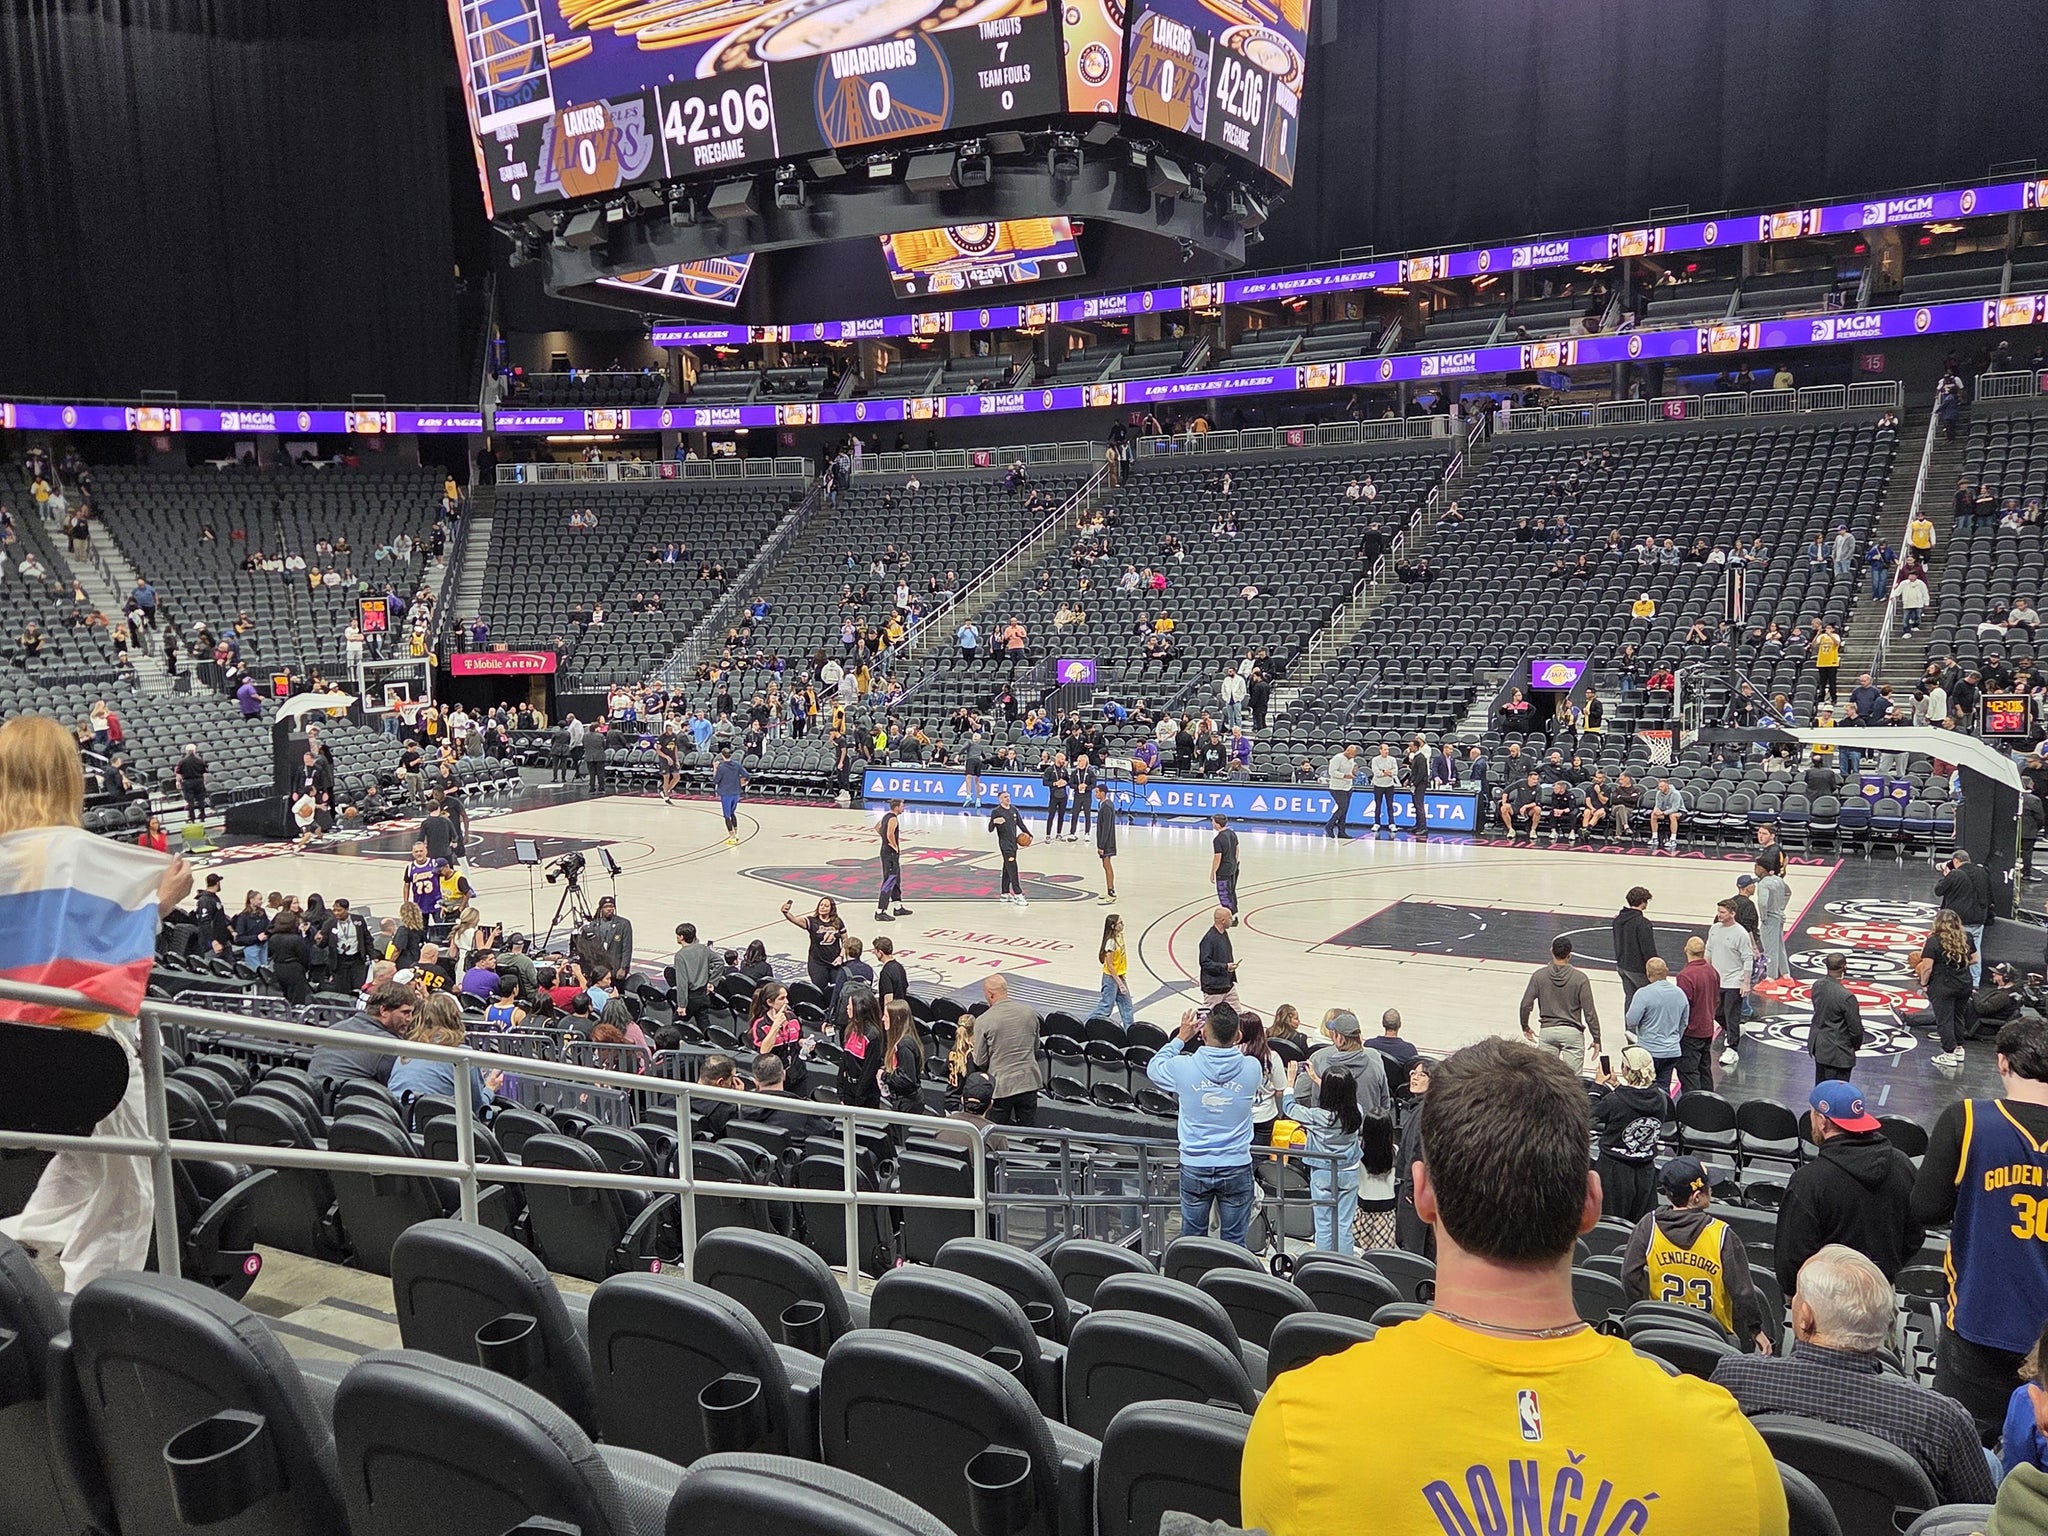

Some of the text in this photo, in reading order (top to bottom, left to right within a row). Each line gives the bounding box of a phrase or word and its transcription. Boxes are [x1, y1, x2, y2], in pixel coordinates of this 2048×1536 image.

[978, 17, 1022, 40] TIMEOUTS
[1152, 16, 1191, 56] LAKERS
[831, 38, 917, 79] WARRIORS
[996, 42, 1009, 62] 7
[978, 64, 1031, 88] TEAM FOULS
[1160, 59, 1175, 103] 0
[1216, 56, 1263, 126] 42:06
[868, 81, 891, 121] 0
[1001, 90, 1014, 110] 0
[562, 104, 605, 138] LAKERS
[664, 84, 770, 145] 42:06
[1222, 121, 1251, 151] PREGAME
[579, 138, 597, 175] 0
[693, 137, 746, 166] PREGAME
[511, 183, 521, 201] 0
[1887, 196, 1934, 213] MGM
[1532, 242, 1569, 258] MGM
[970, 266, 1002, 281] 42:06
[1057, 261, 1067, 273] 0
[906, 282, 915, 293] 0
[1242, 270, 1376, 294] LOS ANGELES LAKERS
[1099, 296, 1127, 308] MGM
[856, 319, 884, 331] MGM
[1836, 315, 1882, 330] MGM
[683, 330, 729, 340] LAKERS
[1440, 353, 1476, 367] MGM
[1865, 356, 1881, 369] 15
[1145, 376, 1274, 395] LOS ANGELES LAKERS
[996, 394, 1024, 406] MGM
[239, 412, 276, 424] MGM
[711, 408, 741, 420] MGM
[1667, 403, 1682, 416] 15
[515, 416, 565, 425] LAKERS
[1290, 432, 1301, 443] 16
[977, 454, 987, 464] 17
[662, 465, 674, 477] 18
[505, 661, 540, 669] ARENA
[889, 778, 944, 795] DELTA
[1168, 791, 1235, 809] DELTA
[415, 880, 434, 895] 73
[893, 949, 1005, 968] RENA
[1984, 1164, 2043, 1192] GOLDEN
[1655, 1251, 1720, 1276] LENDEBORG
[1661, 1272, 1714, 1314] 23
